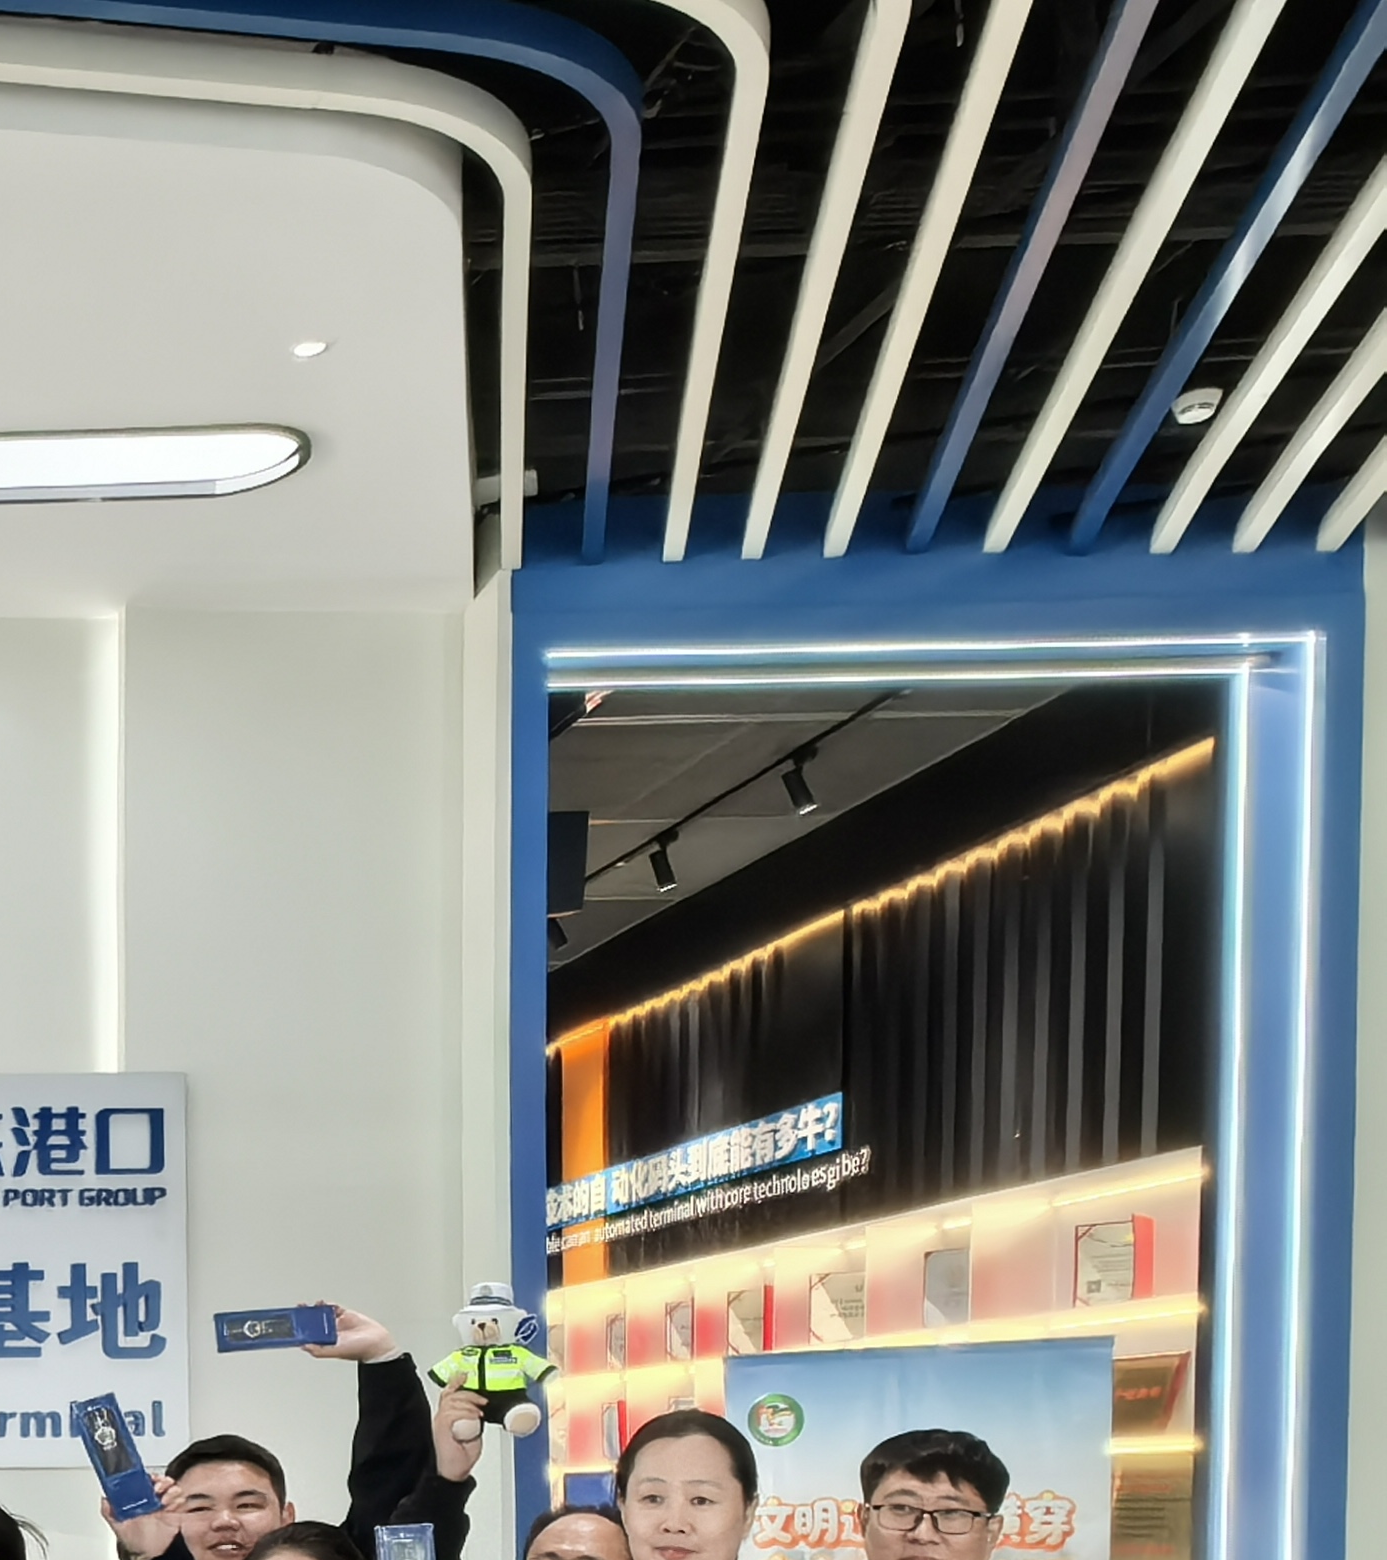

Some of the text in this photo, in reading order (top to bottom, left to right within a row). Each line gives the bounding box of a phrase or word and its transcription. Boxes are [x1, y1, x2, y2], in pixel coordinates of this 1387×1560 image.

[2, 1187, 72, 1209] PORT
[77, 1186, 168, 1208] GROUP
[649, 1197, 695, 1232] terminal
[725, 1184, 752, 1209] core
